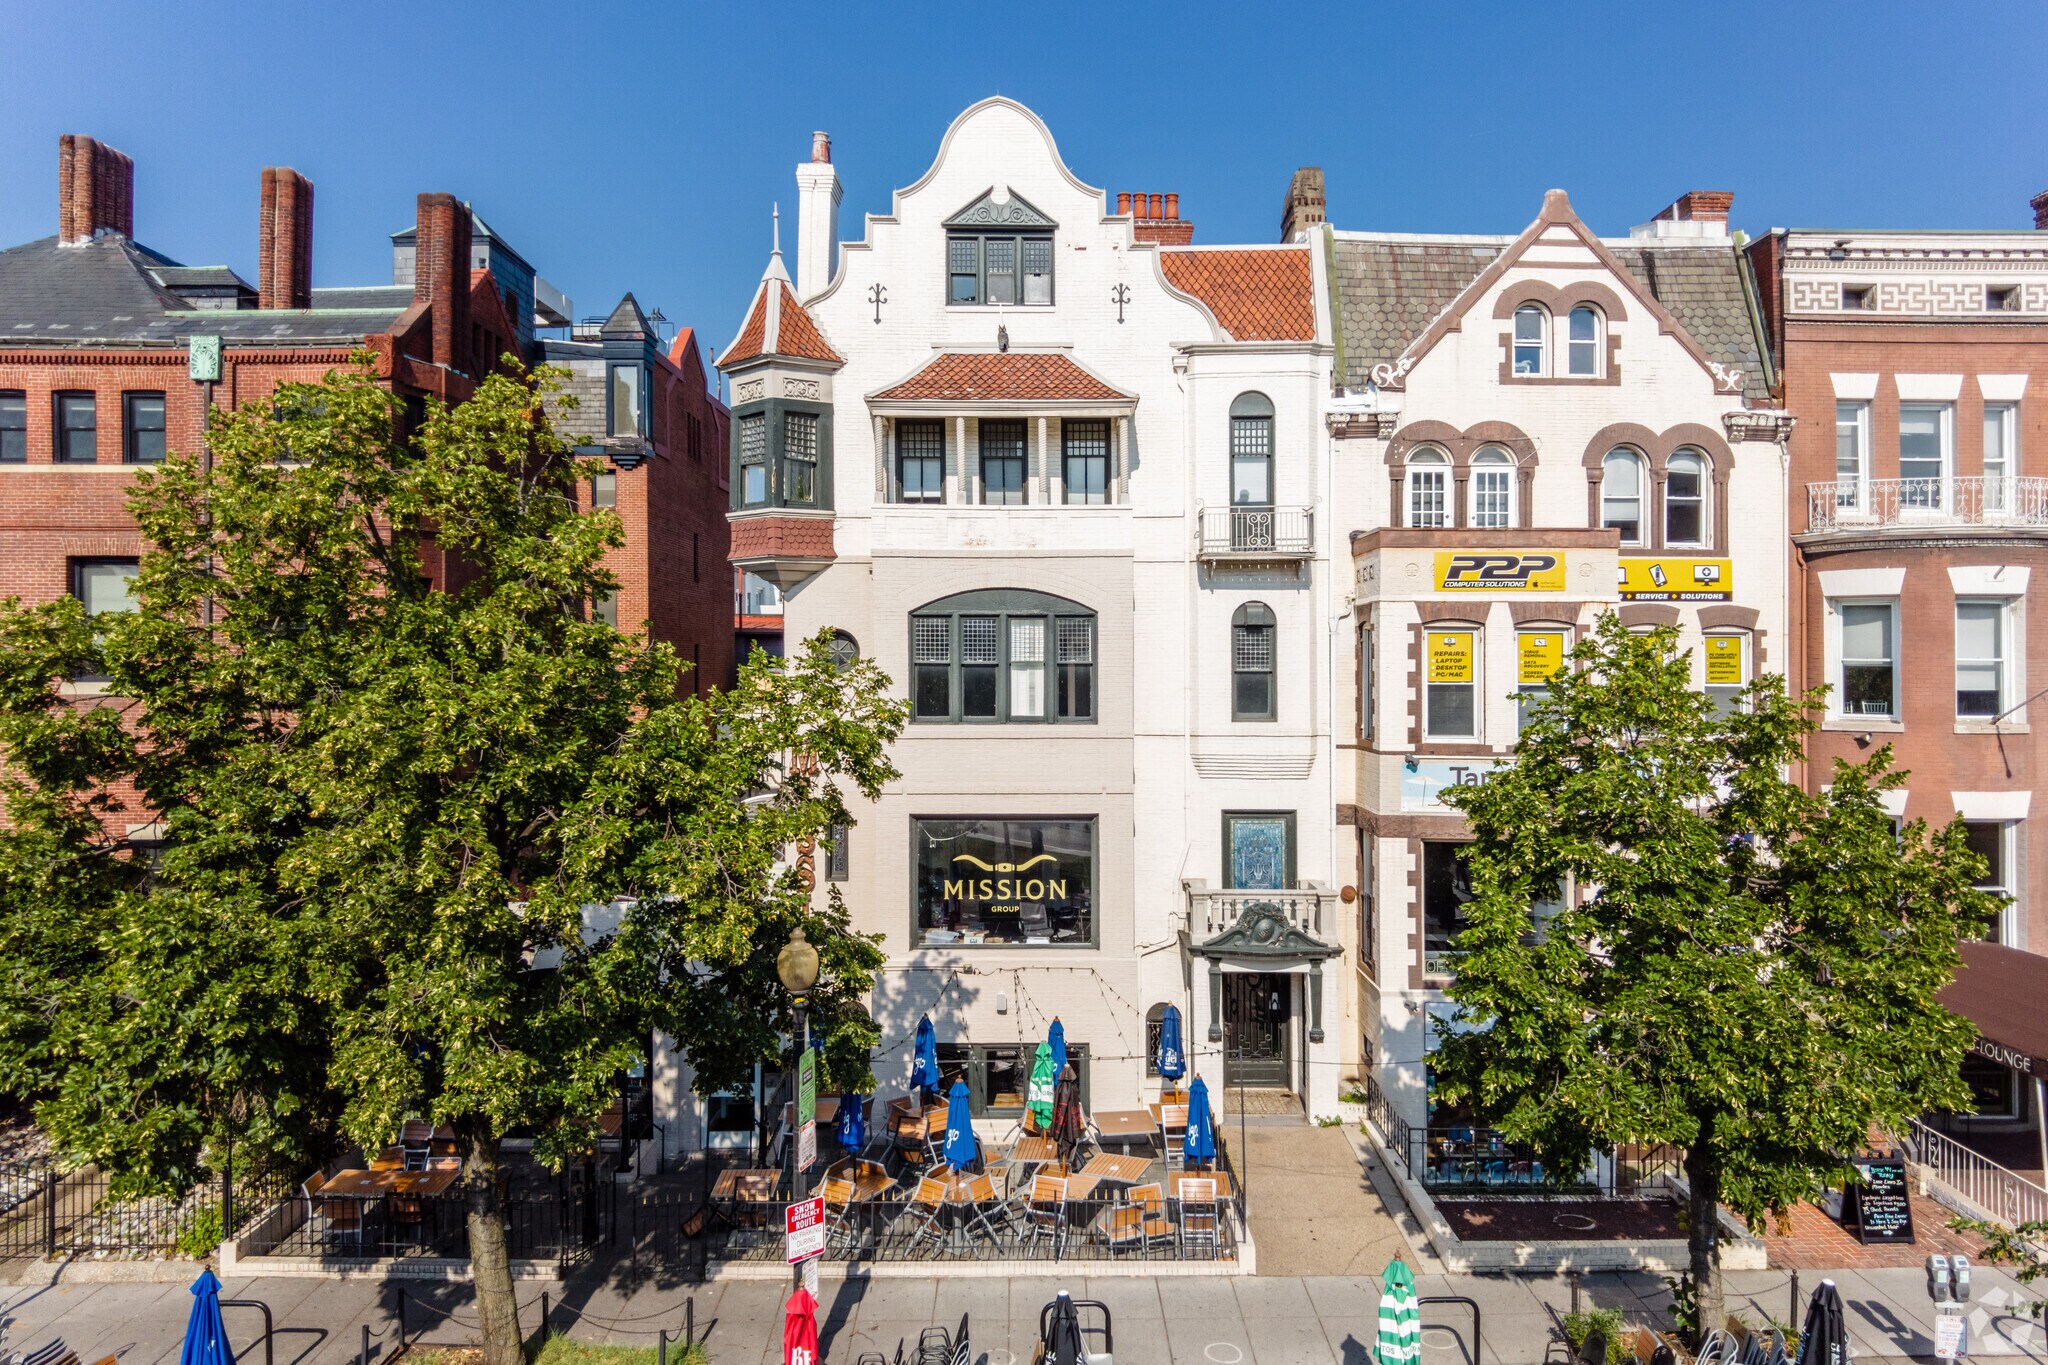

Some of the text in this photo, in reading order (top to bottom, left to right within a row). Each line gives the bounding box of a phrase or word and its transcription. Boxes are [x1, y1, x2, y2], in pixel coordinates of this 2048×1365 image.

[1446, 555, 1556, 580] P2P
[943, 879, 1067, 900] MISSION
[990, 905, 1020, 913] GROUP
[794, 1201, 815, 1215] SNOW
[791, 1208, 820, 1223] EMERGENCY
[795, 1216, 816, 1230] ROUTE
[790, 1225, 822, 1241] NO PARKING
[796, 1235, 816, 1248] DURING
[791, 1243, 820, 1257] EMERGENCY
